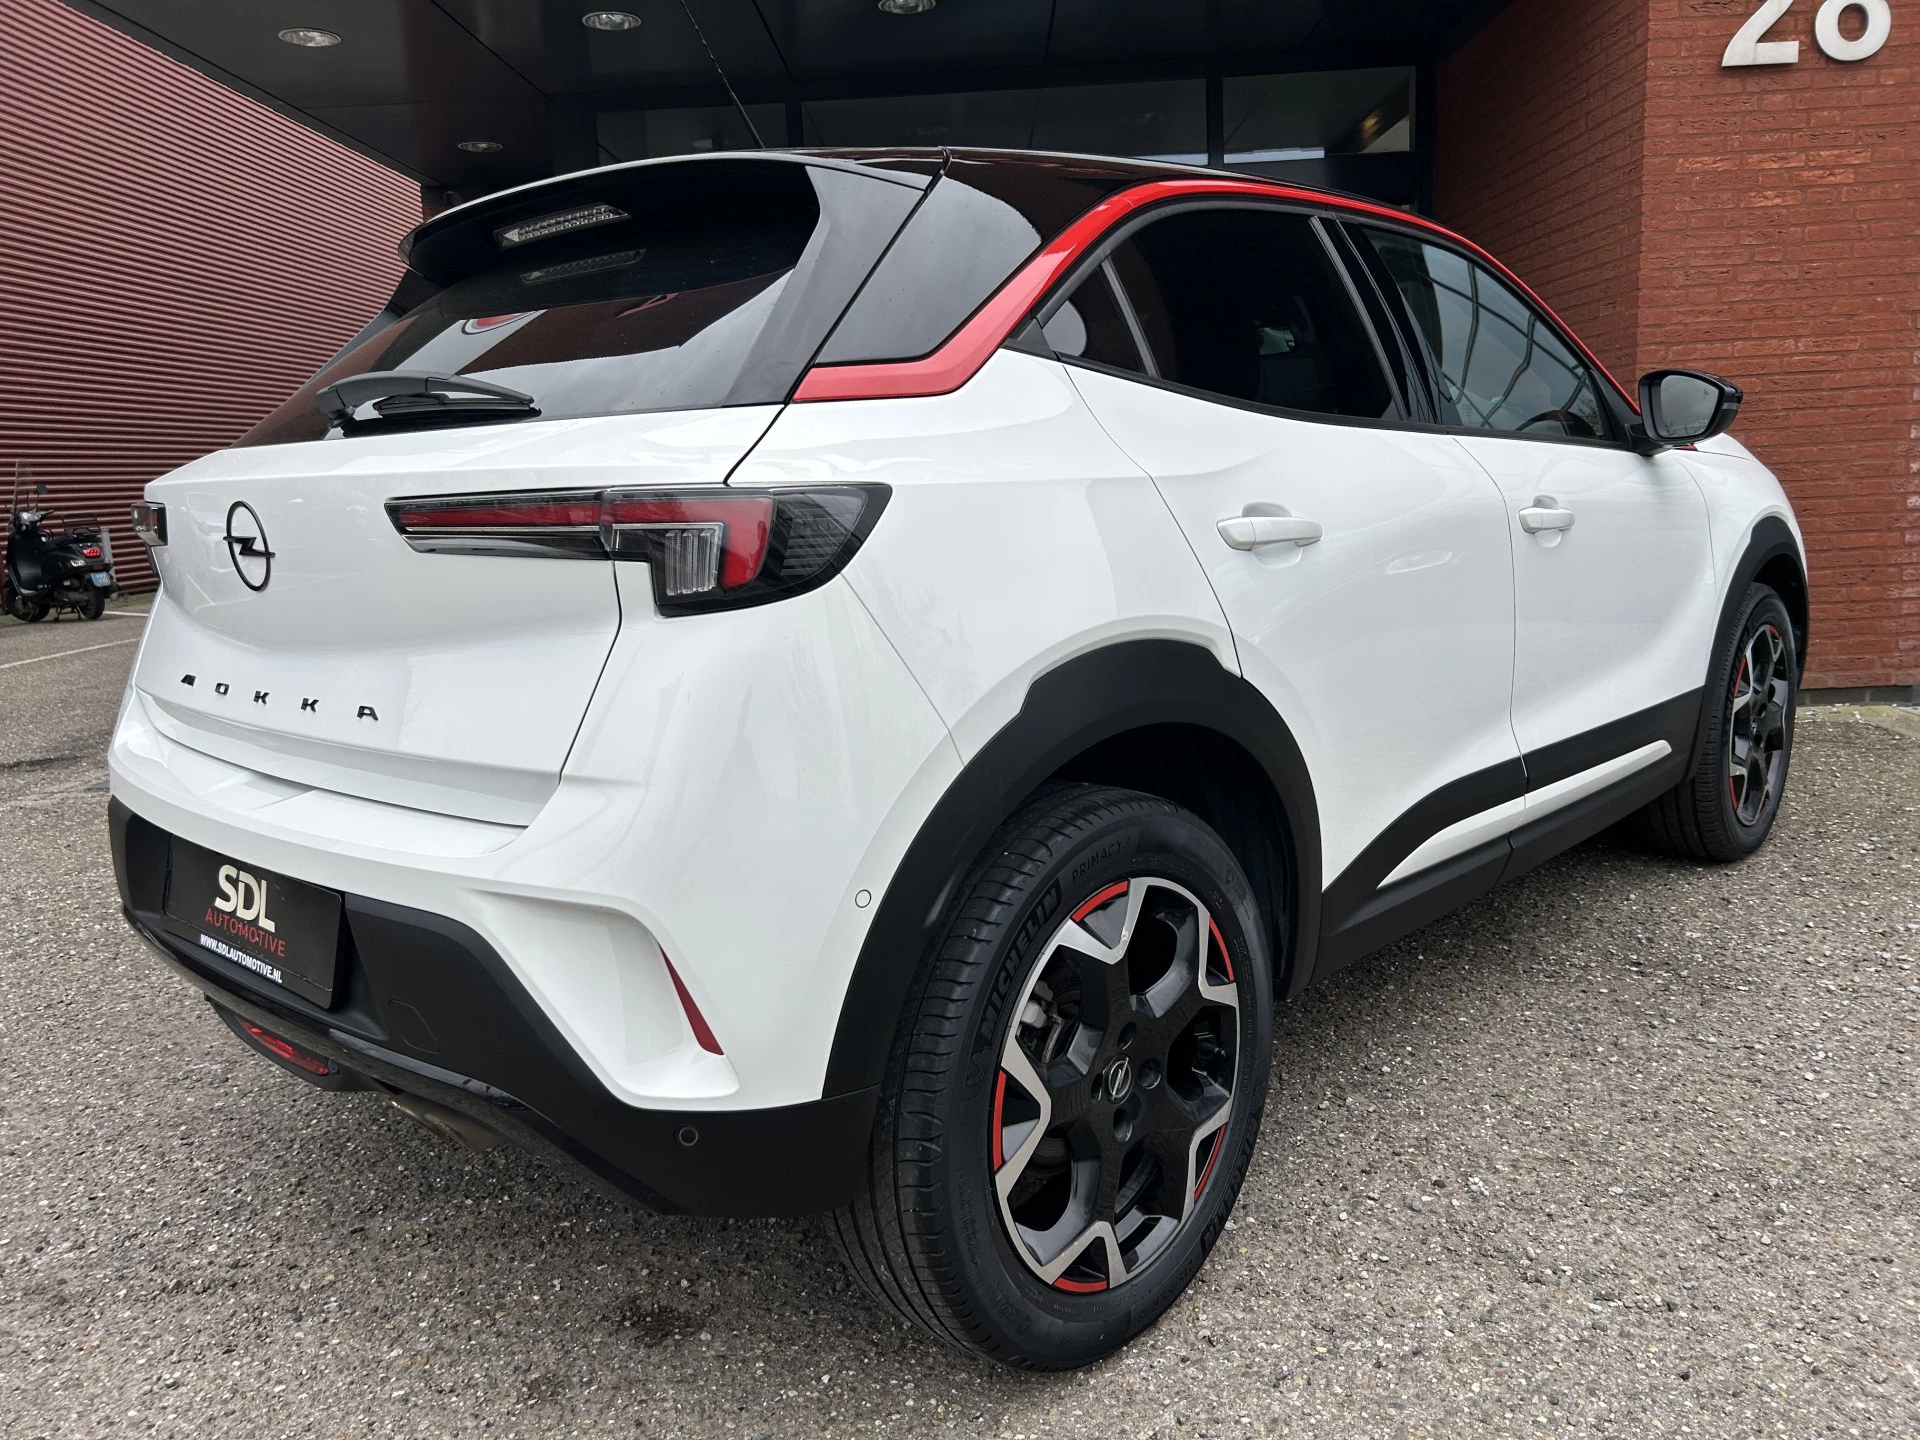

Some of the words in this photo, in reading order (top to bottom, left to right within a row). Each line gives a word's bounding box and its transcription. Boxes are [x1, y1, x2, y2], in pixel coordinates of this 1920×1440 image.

[180, 673, 379, 722] MOKKA
[1072, 839, 1123, 884] PRIMACY
[214, 864, 276, 933] SDL
[204, 907, 286, 957] AUTOMOTIVE
[199, 933, 283, 984] WWW.SDLAUTOMOTIVE.NL
[979, 886, 1060, 1039] MICHELIN
